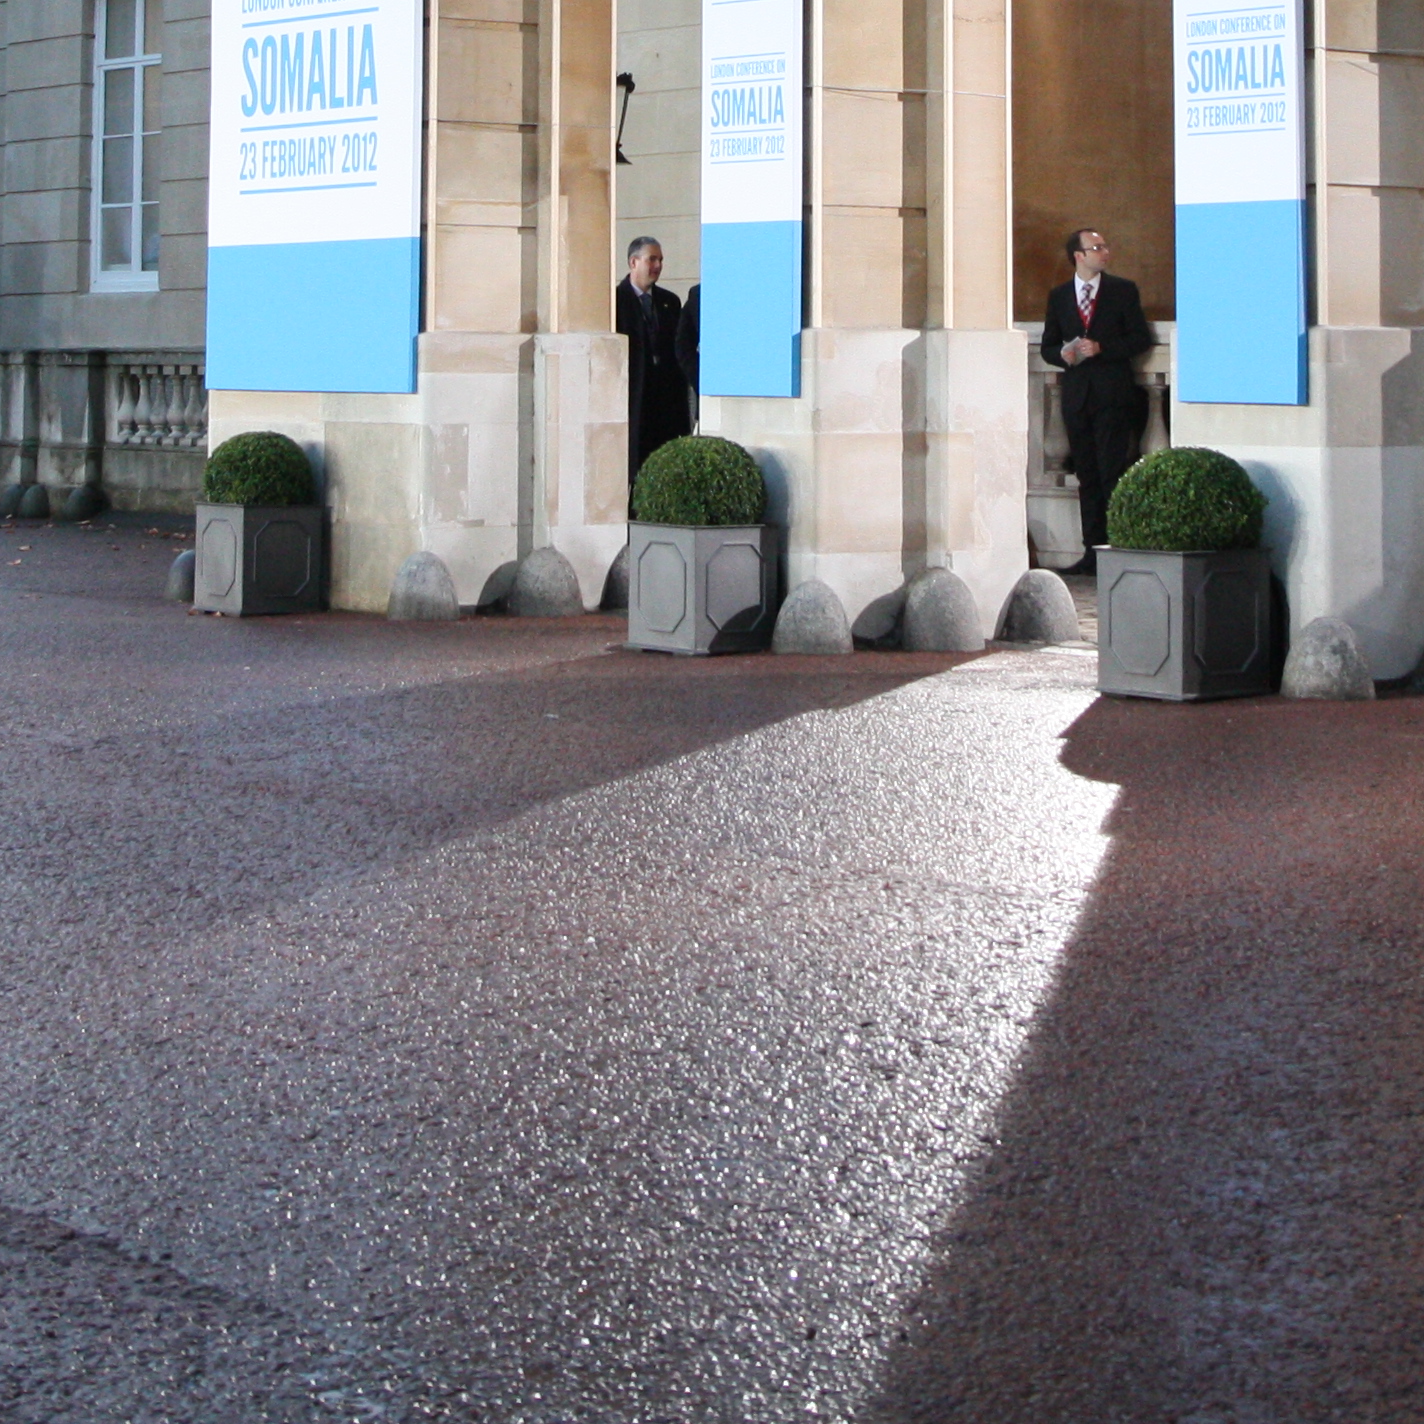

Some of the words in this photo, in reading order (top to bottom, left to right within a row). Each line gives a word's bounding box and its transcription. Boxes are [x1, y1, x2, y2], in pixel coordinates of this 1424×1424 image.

[1186, 19, 1218, 38] LONDON
[1219, 14, 1271, 35] CONFERENCE
[1273, 13, 1286, 30] ON
[241, 23, 378, 118] SOMALIA
[710, 63, 735, 79] LONDON
[736, 59, 775, 77] CONFERENCE
[777, 58, 785, 73] ON
[1186, 43, 1286, 94] SOMALIA
[710, 85, 785, 128] SOMALIA
[1187, 106, 1200, 128] 23
[1203, 102, 1257, 127] FEBRUARY
[1260, 100, 1286, 123] 2012
[239, 141, 257, 181] 23
[261, 135, 336, 179] FEBRUARY
[341, 131, 378, 173] 2012
[710, 138, 720, 158] 23
[722, 136, 763, 157] FEBRUARY
[765, 135, 785, 155] 2012
